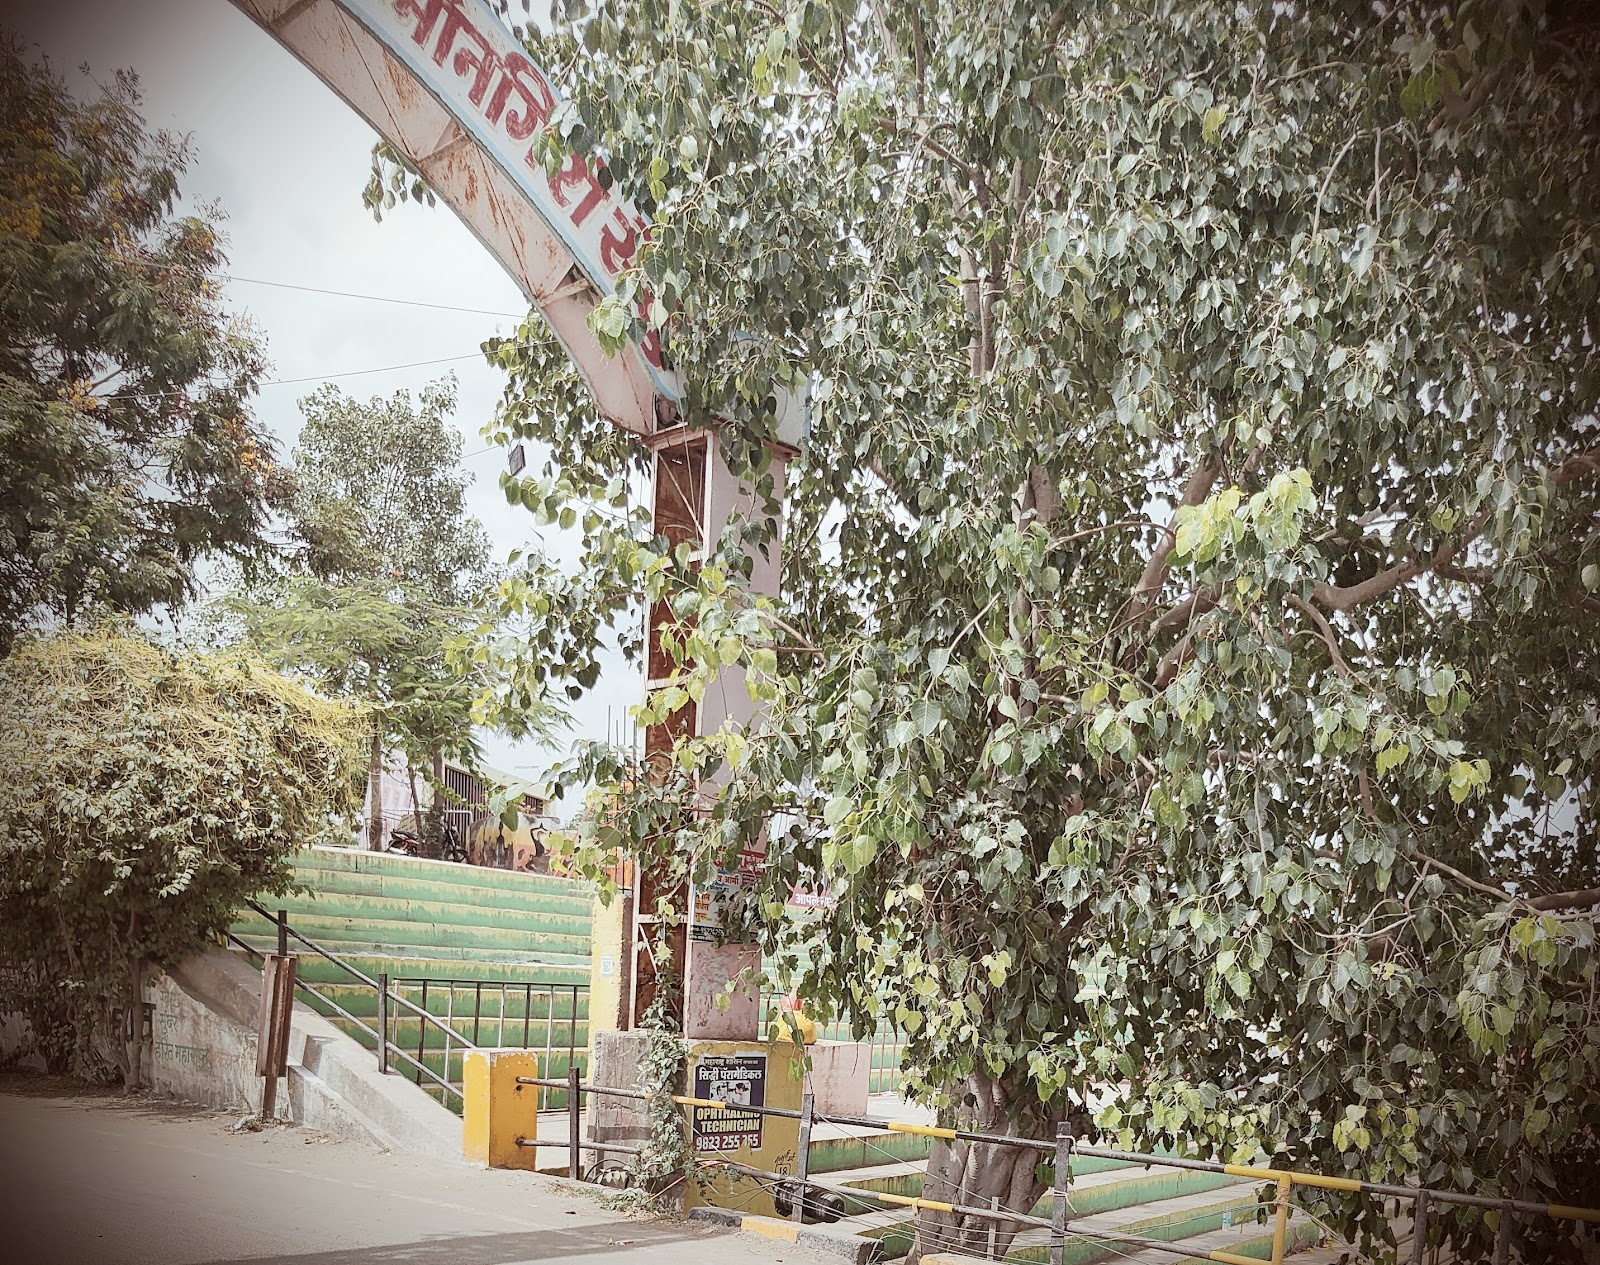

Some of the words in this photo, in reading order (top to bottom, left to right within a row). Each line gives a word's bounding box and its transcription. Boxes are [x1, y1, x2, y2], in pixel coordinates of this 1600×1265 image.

[700, 1119, 760, 1133] TECHNICIAN
[696, 1135, 721, 1150] 9823
[722, 1134, 741, 1148] 255
